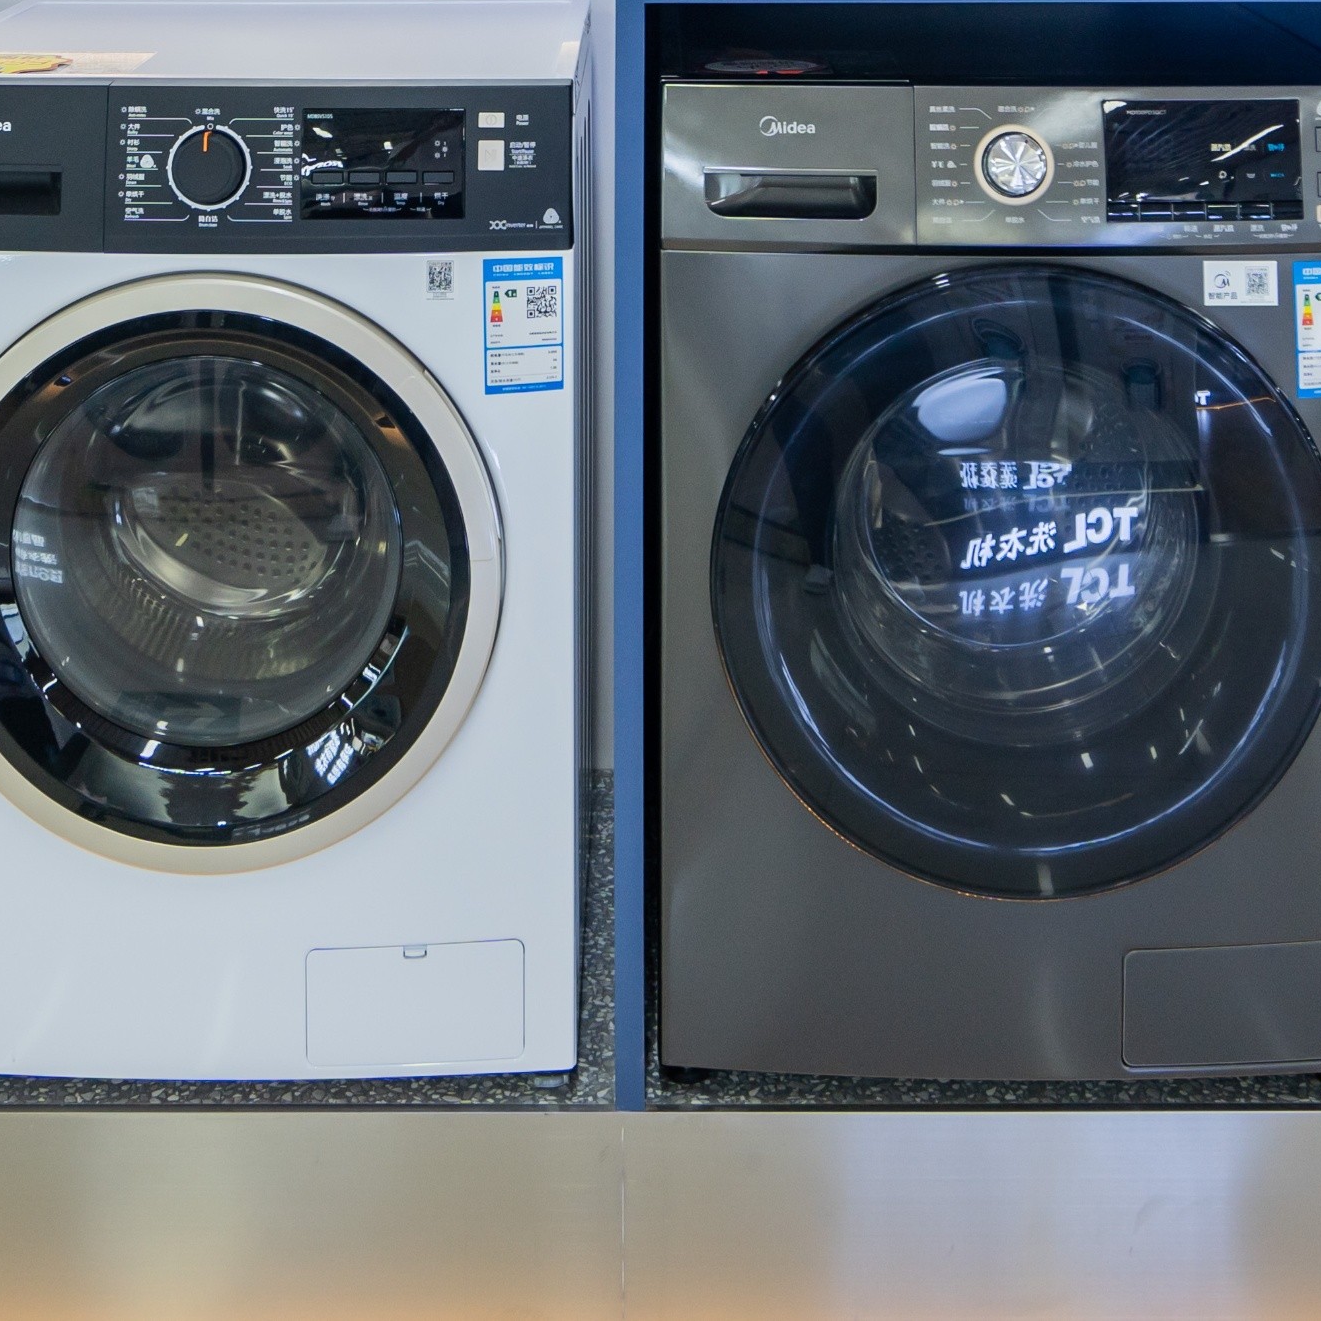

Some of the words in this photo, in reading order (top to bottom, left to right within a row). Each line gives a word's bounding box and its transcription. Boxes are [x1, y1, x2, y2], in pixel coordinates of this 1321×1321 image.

[759, 115, 816, 137] Midea
[492, 262, 554, 273] 中国能效标识
[1208, 291, 1238, 300] 智能产品
